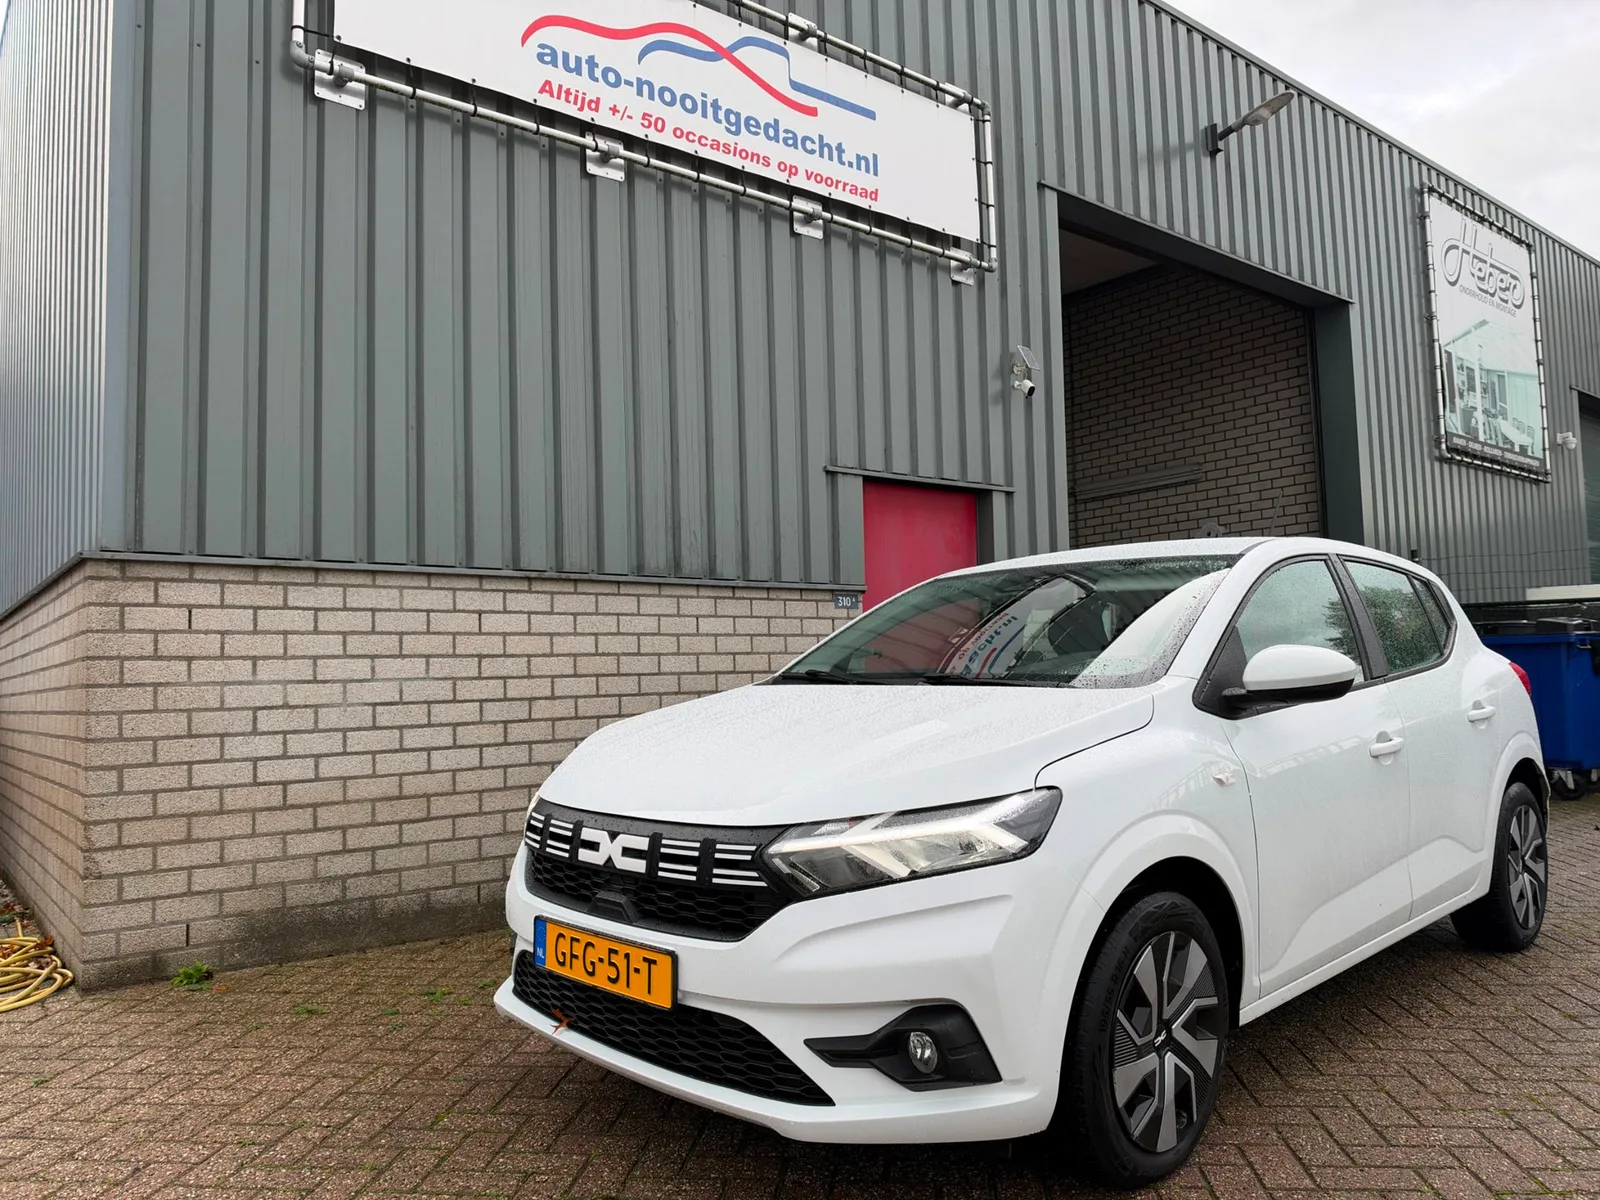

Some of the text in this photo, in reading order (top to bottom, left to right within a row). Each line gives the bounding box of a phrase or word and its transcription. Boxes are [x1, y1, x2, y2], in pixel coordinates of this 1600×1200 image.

[536, 42, 880, 177] auto-nooitgedacht.nl
[538, 79, 879, 202] Altijd +/- 50 occasions op voorraad
[537, 947, 545, 959] NL
[554, 932, 657, 995] GFG-51-T
